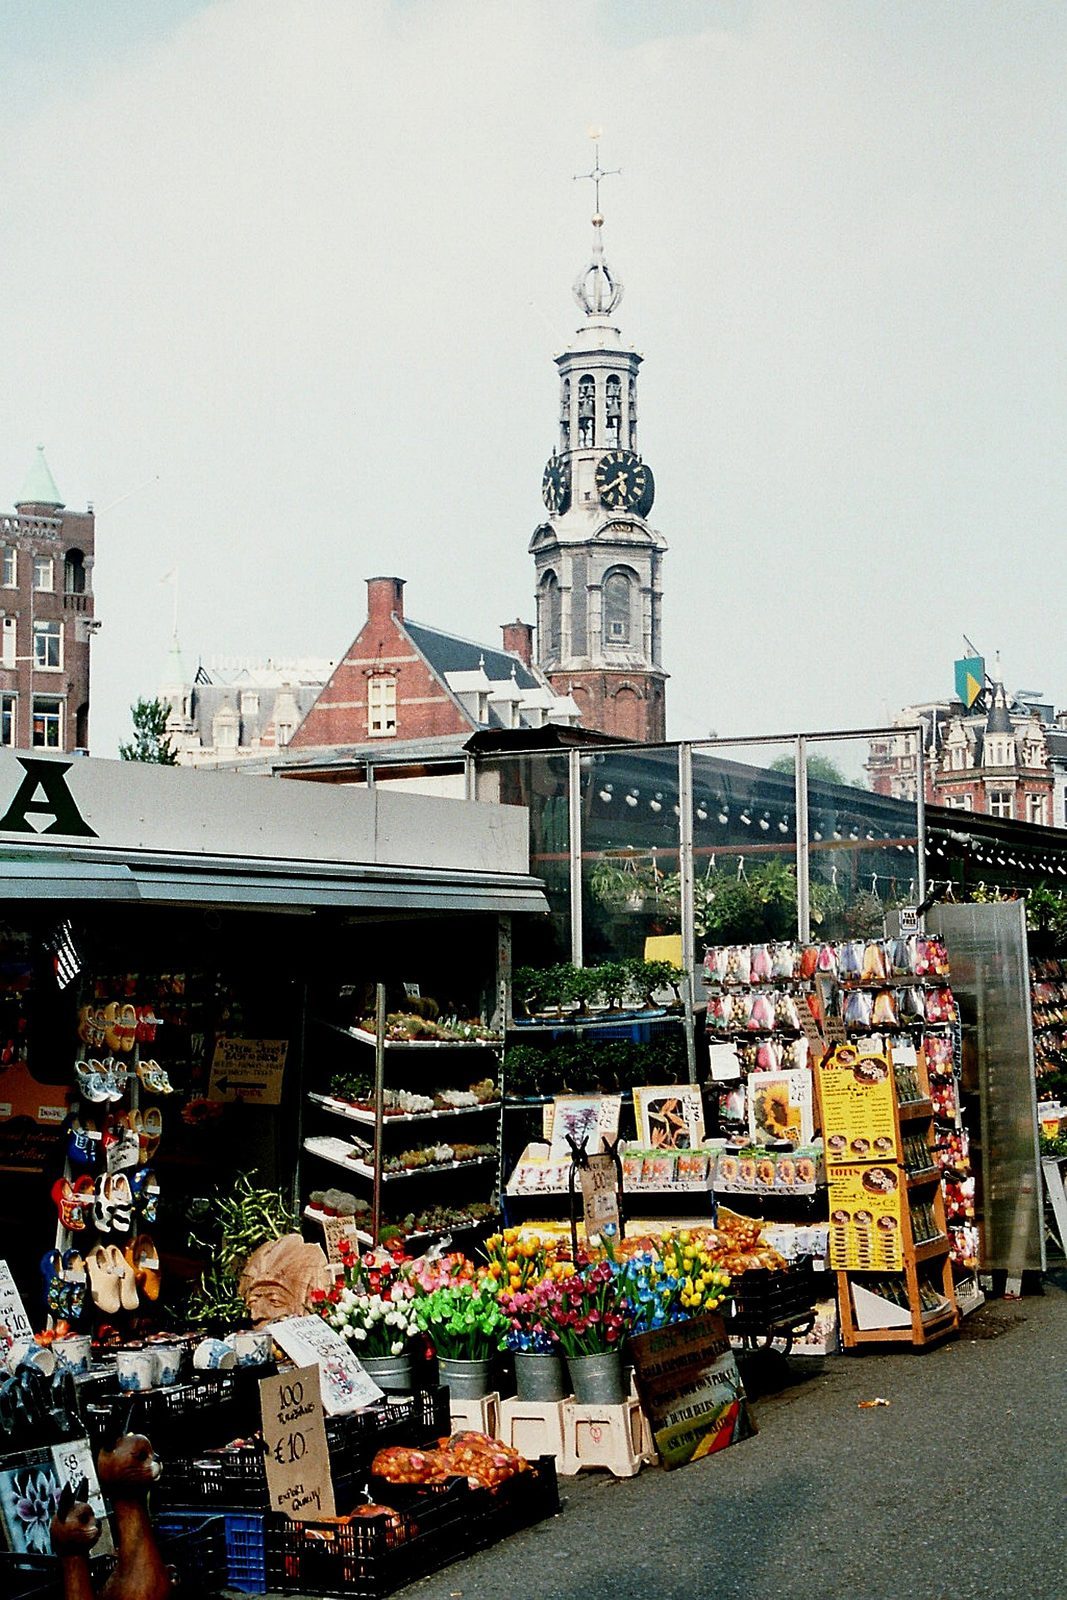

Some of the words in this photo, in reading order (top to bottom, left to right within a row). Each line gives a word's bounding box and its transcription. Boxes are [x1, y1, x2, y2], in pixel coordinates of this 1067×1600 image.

[0, 757, 99, 838] A
[830, 1168, 860, 1177] LOTUS
[279, 1381, 304, 1410] 100
[669, 1407, 693, 1424] DUTCH
[693, 1399, 715, 1416] BULBS
